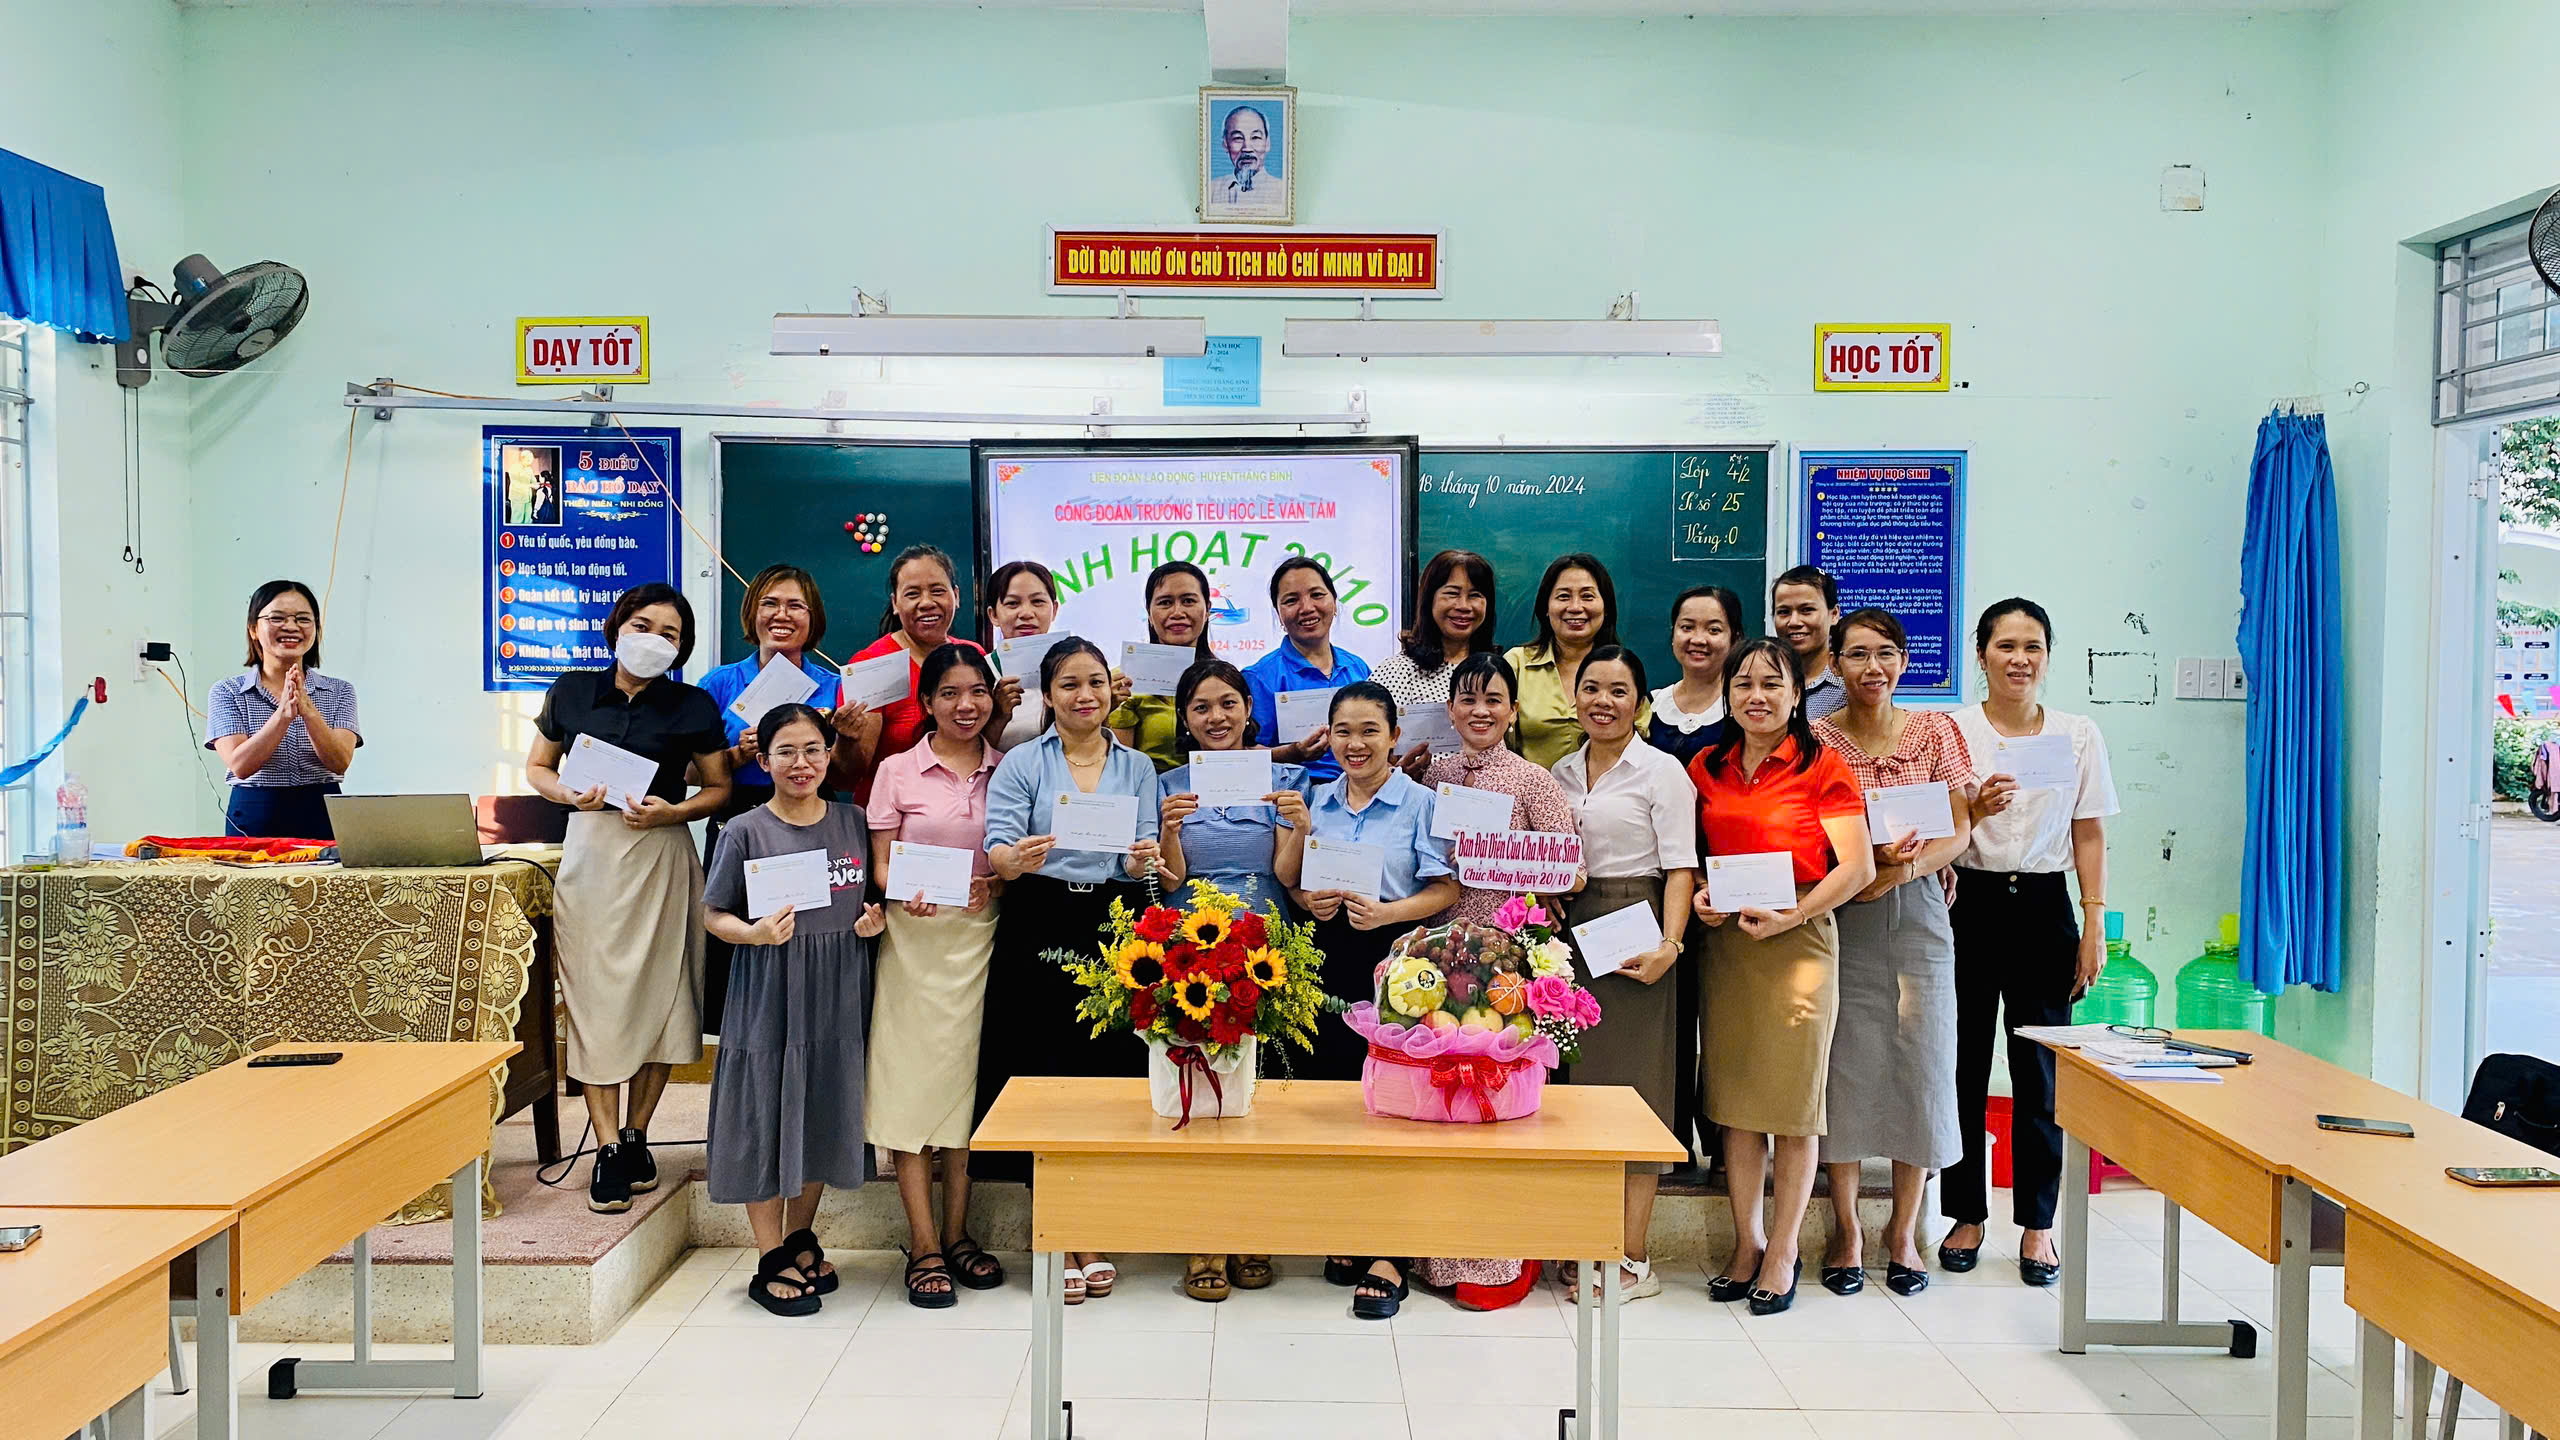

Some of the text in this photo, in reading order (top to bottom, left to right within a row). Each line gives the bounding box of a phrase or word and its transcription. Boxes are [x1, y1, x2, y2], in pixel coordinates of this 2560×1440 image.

[1068, 245, 1095, 274] ĐỜI
[1099, 245, 1126, 275] ĐỜI
[1130, 246, 1162, 276] NHỚ
[1165, 247, 1186, 276] ƠN
[1191, 245, 1222, 276] CHỦ
[1227, 251, 1262, 281] TỊCH
[1266, 243, 1288, 277] HỒ
[1292, 248, 1319, 277] CHÍ
[1323, 252, 1363, 278] MINH
[1367, 248, 1384, 278] VĨ
[1387, 252, 1414, 282] ĐẠI
[533, 328, 633, 372] DẠY TỐT
[1830, 335, 1934, 379] HỌC TỐT
[579, 450, 640, 471] 5 ĐIỀU
[1727, 463, 1750, 483] 4/2
[1837, 467, 1931, 482] NHIỆM VỤ HỌC SINH
[565, 476, 660, 497] BÁC HỒ DẠY
[1418, 470, 1586, 508] 18 tháng 10 năm 2024
[620, 500, 636, 508] NHI
[637, 498, 665, 508] ĐỒNG
[1722, 492, 1745, 512] 25
[518, 533, 535, 548] Yêu
[549, 533, 573, 549] quốc,
[575, 535, 592, 549] yêu
[594, 533, 617, 550] đồng
[619, 536, 639, 549] bào.
[518, 562, 536, 577] Học
[538, 562, 553, 578] tập
[571, 562, 587, 576] lao
[588, 562, 611, 578] động
[1050, 543, 1115, 605] NH
[1131, 530, 1269, 575] HOẠT
[592, 589, 611, 606] luật
[568, 617, 589, 631] sinh
[572, 645, 592, 661] thật
[1209, 639, 1230, 650] 024
[1458, 831, 1581, 869] Ban Đại Diện Của Cha Mẹ Học Sinh
[832, 856, 852, 870] you
[827, 867, 865, 887] ever
[1464, 867, 1571, 888] Chúc Mừng Ngày 20/10
